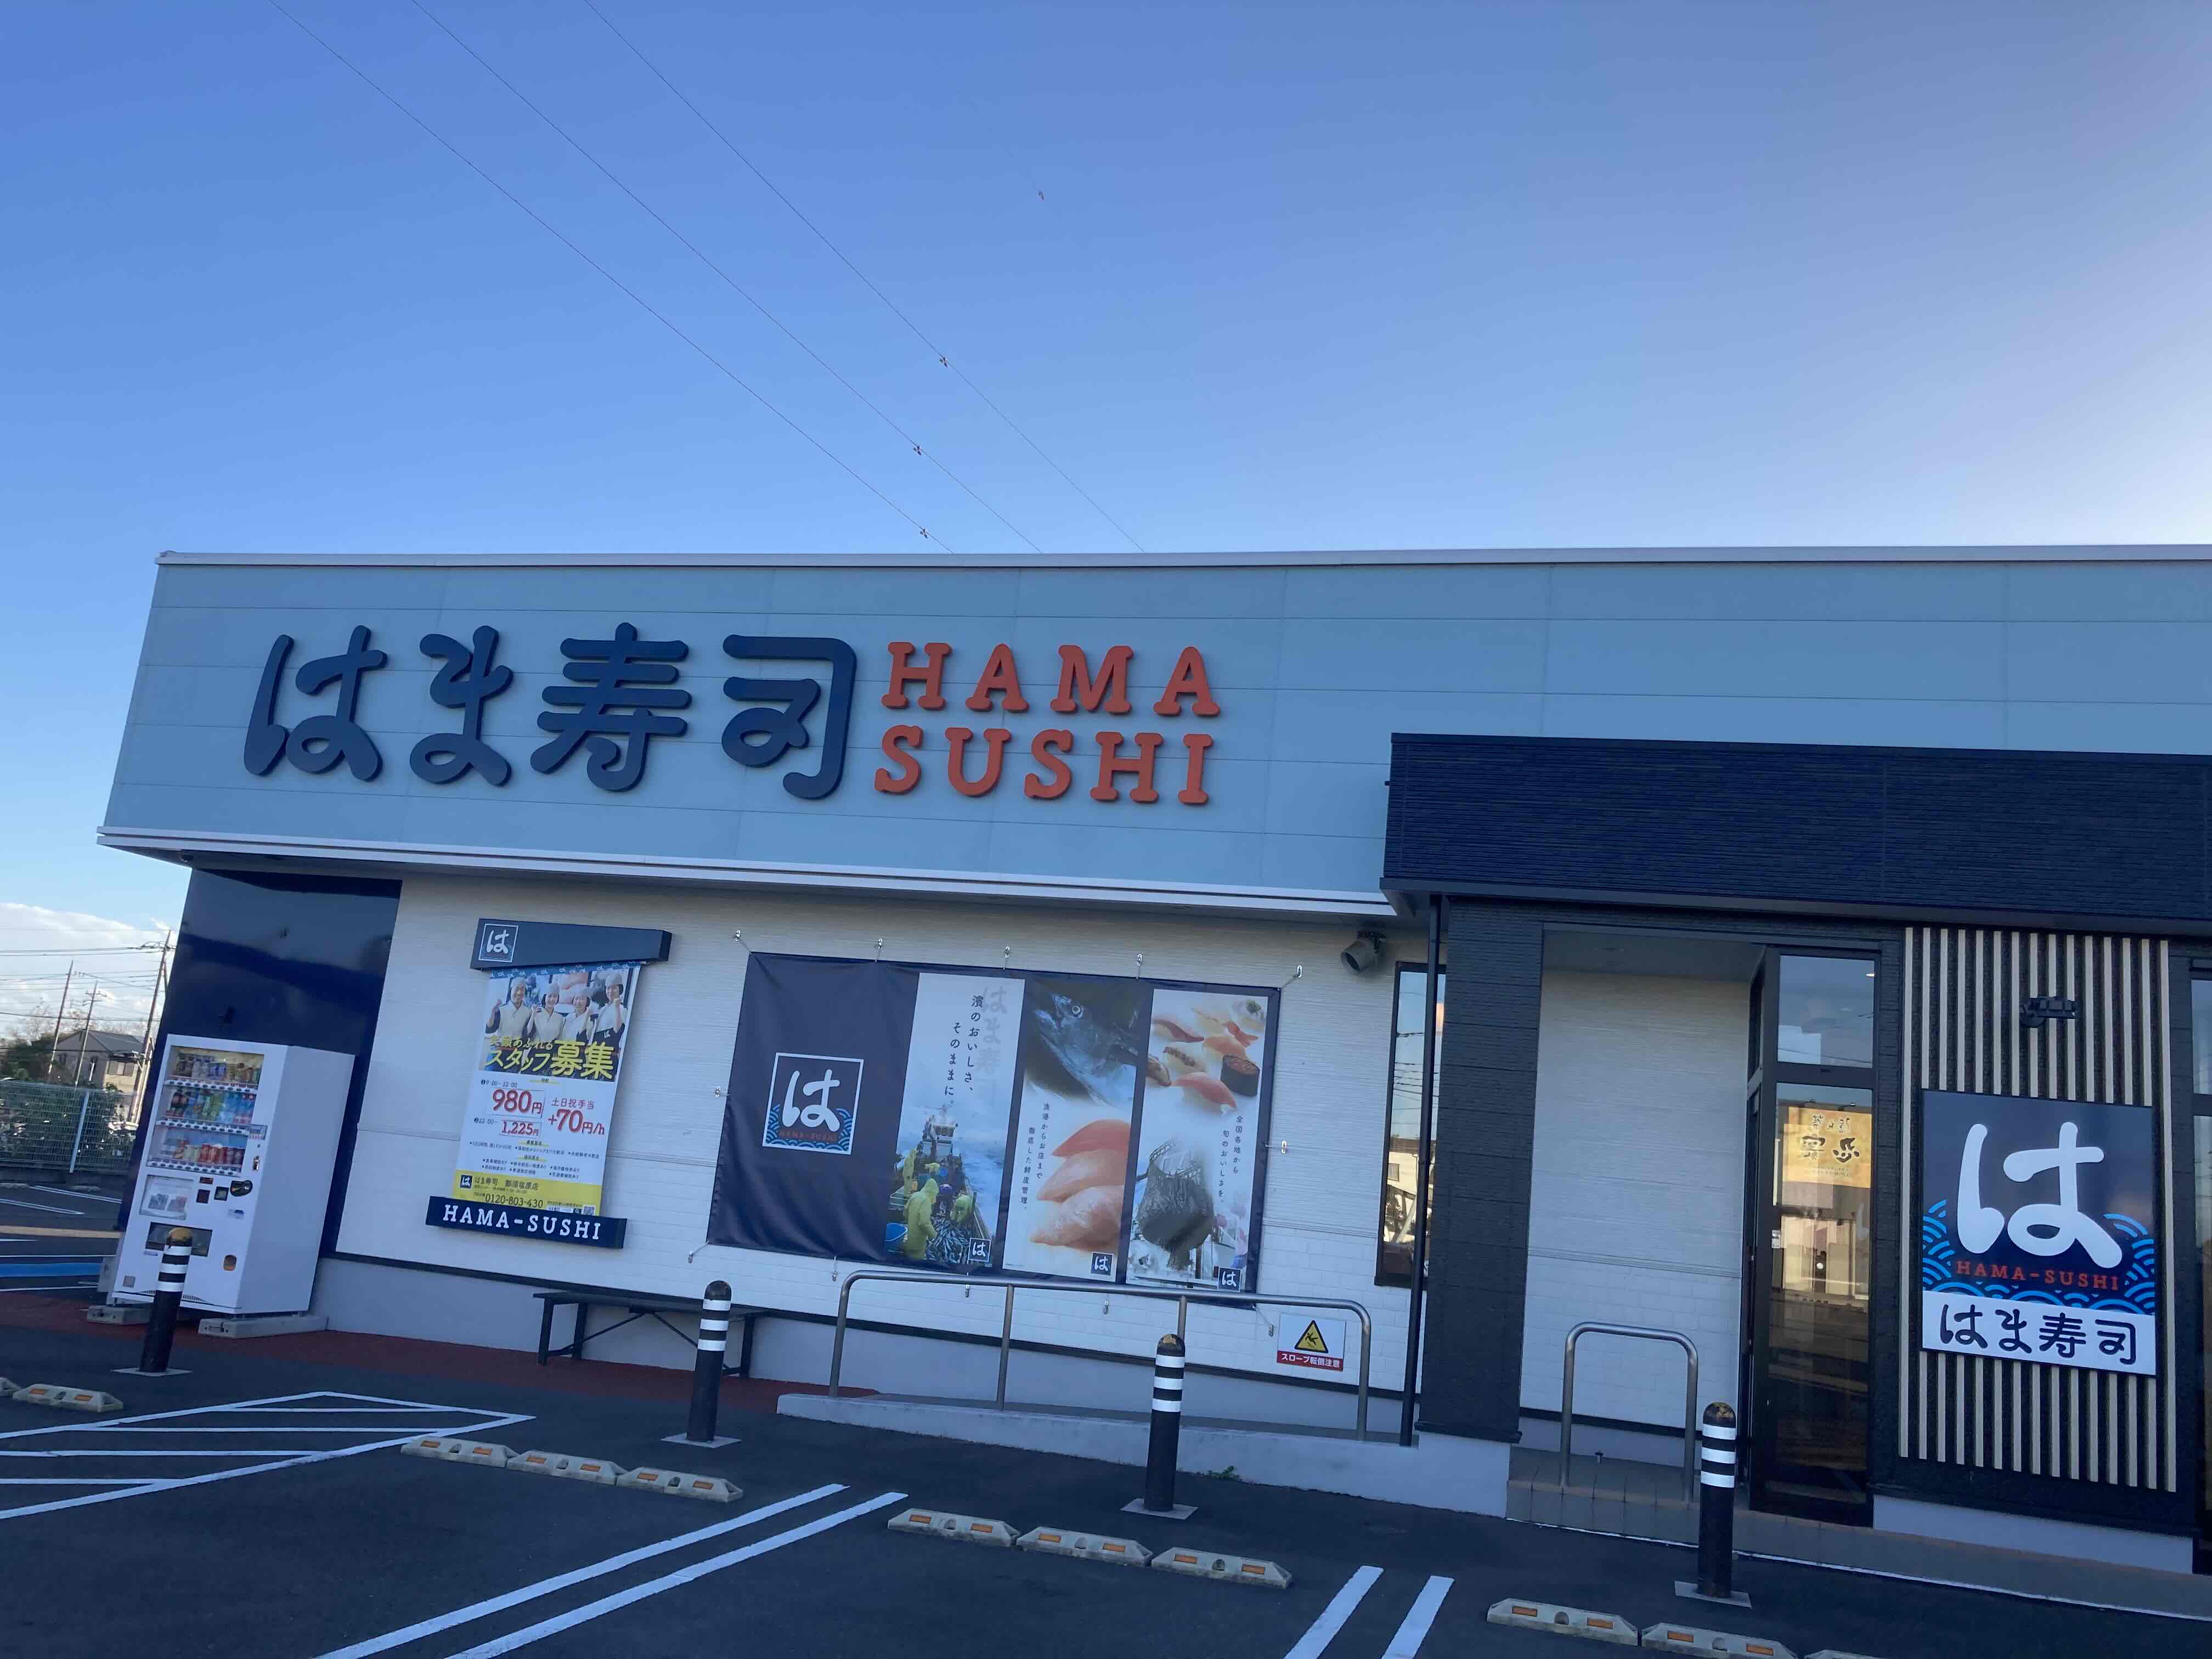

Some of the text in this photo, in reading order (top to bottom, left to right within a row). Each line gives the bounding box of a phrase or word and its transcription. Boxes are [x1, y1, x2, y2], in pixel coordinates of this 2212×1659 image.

[881, 641, 1221, 716] HAMA
[243, 622, 857, 799] はま寿司
[874, 723, 1214, 804] SUSHI
[487, 929, 509, 954] は
[484, 1040, 614, 1080] スタッフ募集
[964, 995, 984, 1092] 濱のおいしさ、
[945, 1022, 961, 1104] そのままに。
[492, 1088, 542, 1115] 980円
[550, 1097, 595, 1110] 土日祝手当
[782, 1069, 840, 1132] は
[485, 1194, 544, 1208] 0120-803-430
[1957, 1121, 2122, 1268] は
[443, 1204, 601, 1240] HAMA-SUSHI
[972, 1242, 986, 1258] は
[1094, 1255, 1109, 1272] は
[1222, 1271, 1237, 1287] は
[1956, 1259, 2120, 1291] HAMA-SUSHI
[1940, 1303, 2136, 1364] はま寿司
[1281, 1353, 1340, 1368] スロープ転倒注意
